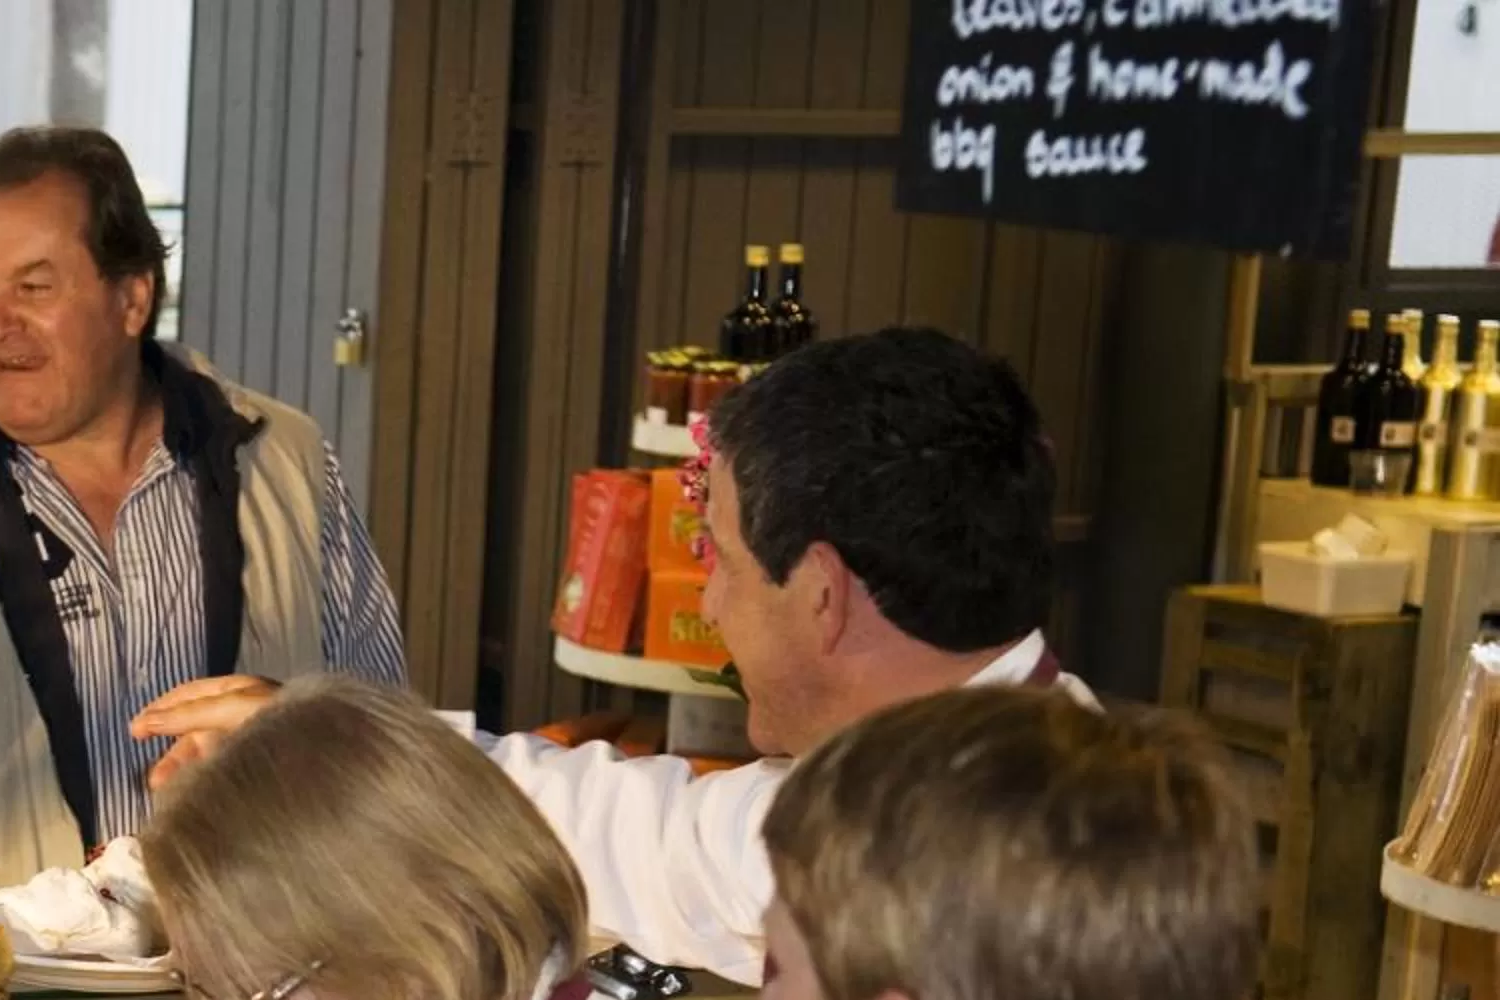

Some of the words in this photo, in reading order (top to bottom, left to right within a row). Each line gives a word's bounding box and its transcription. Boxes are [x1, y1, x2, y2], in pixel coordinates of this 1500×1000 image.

[937, 52, 1035, 107] onion
[930, 117, 996, 203] bbq
[1024, 127, 1148, 178] sauce
